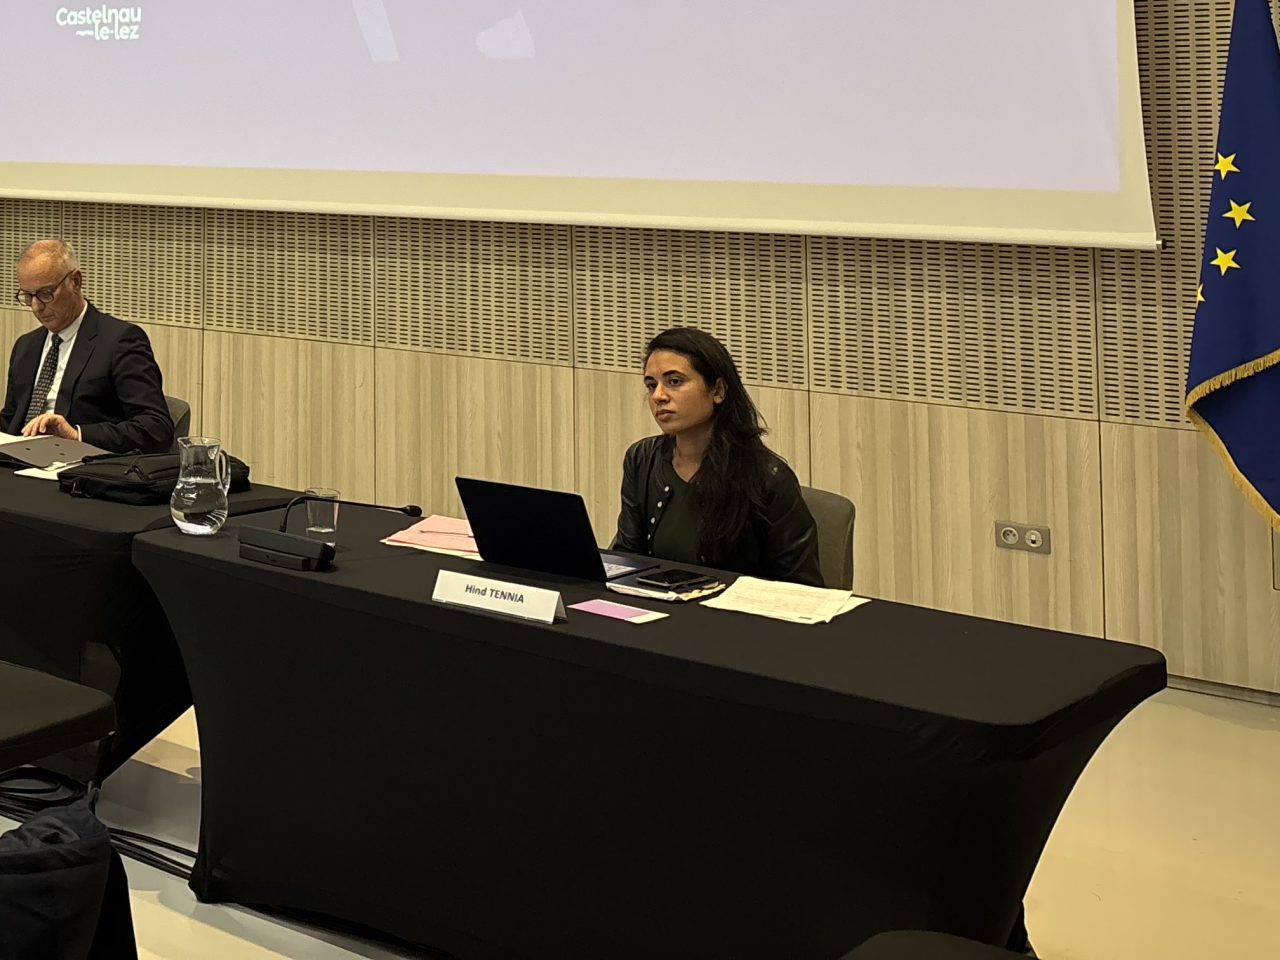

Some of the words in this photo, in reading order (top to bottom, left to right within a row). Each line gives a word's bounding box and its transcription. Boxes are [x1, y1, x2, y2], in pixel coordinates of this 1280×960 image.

[55, 3, 142, 26] Castelnau
[465, 584, 487, 596] Hind
[489, 588, 525, 604] TENNIA
